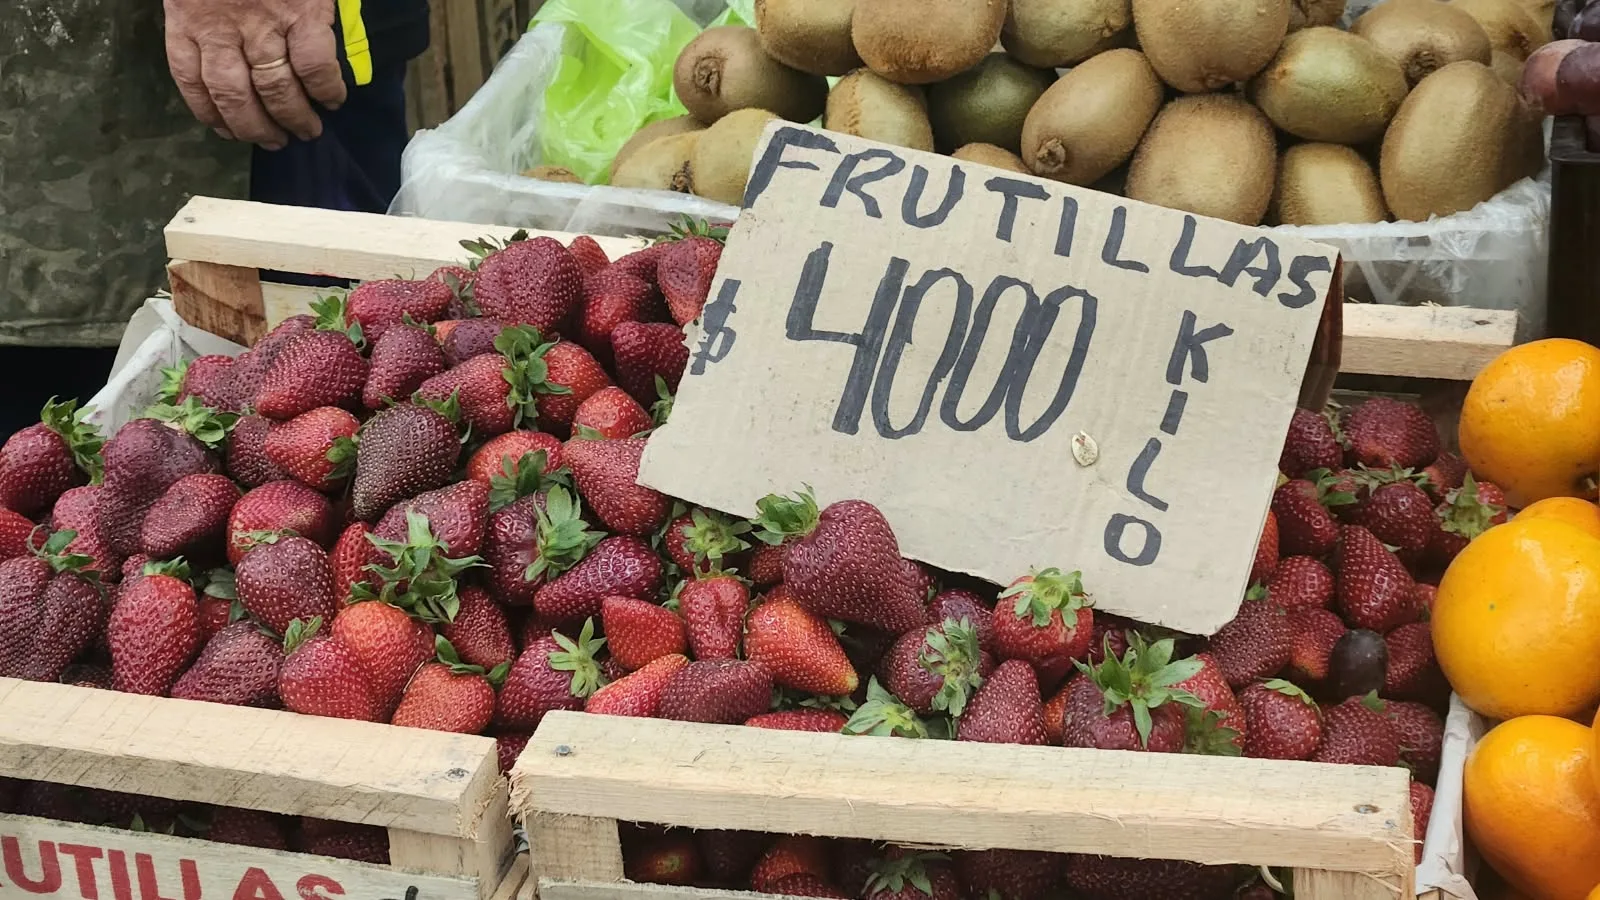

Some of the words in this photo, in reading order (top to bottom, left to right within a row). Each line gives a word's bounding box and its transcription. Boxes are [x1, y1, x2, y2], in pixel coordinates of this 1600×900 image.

[743, 125, 1333, 309] FRUTILLAS
[690, 278, 742, 376] $
[785, 241, 1099, 443] 4000
[1104, 309, 1234, 567] KILO
[0, 836, 346, 900] UTILLA
